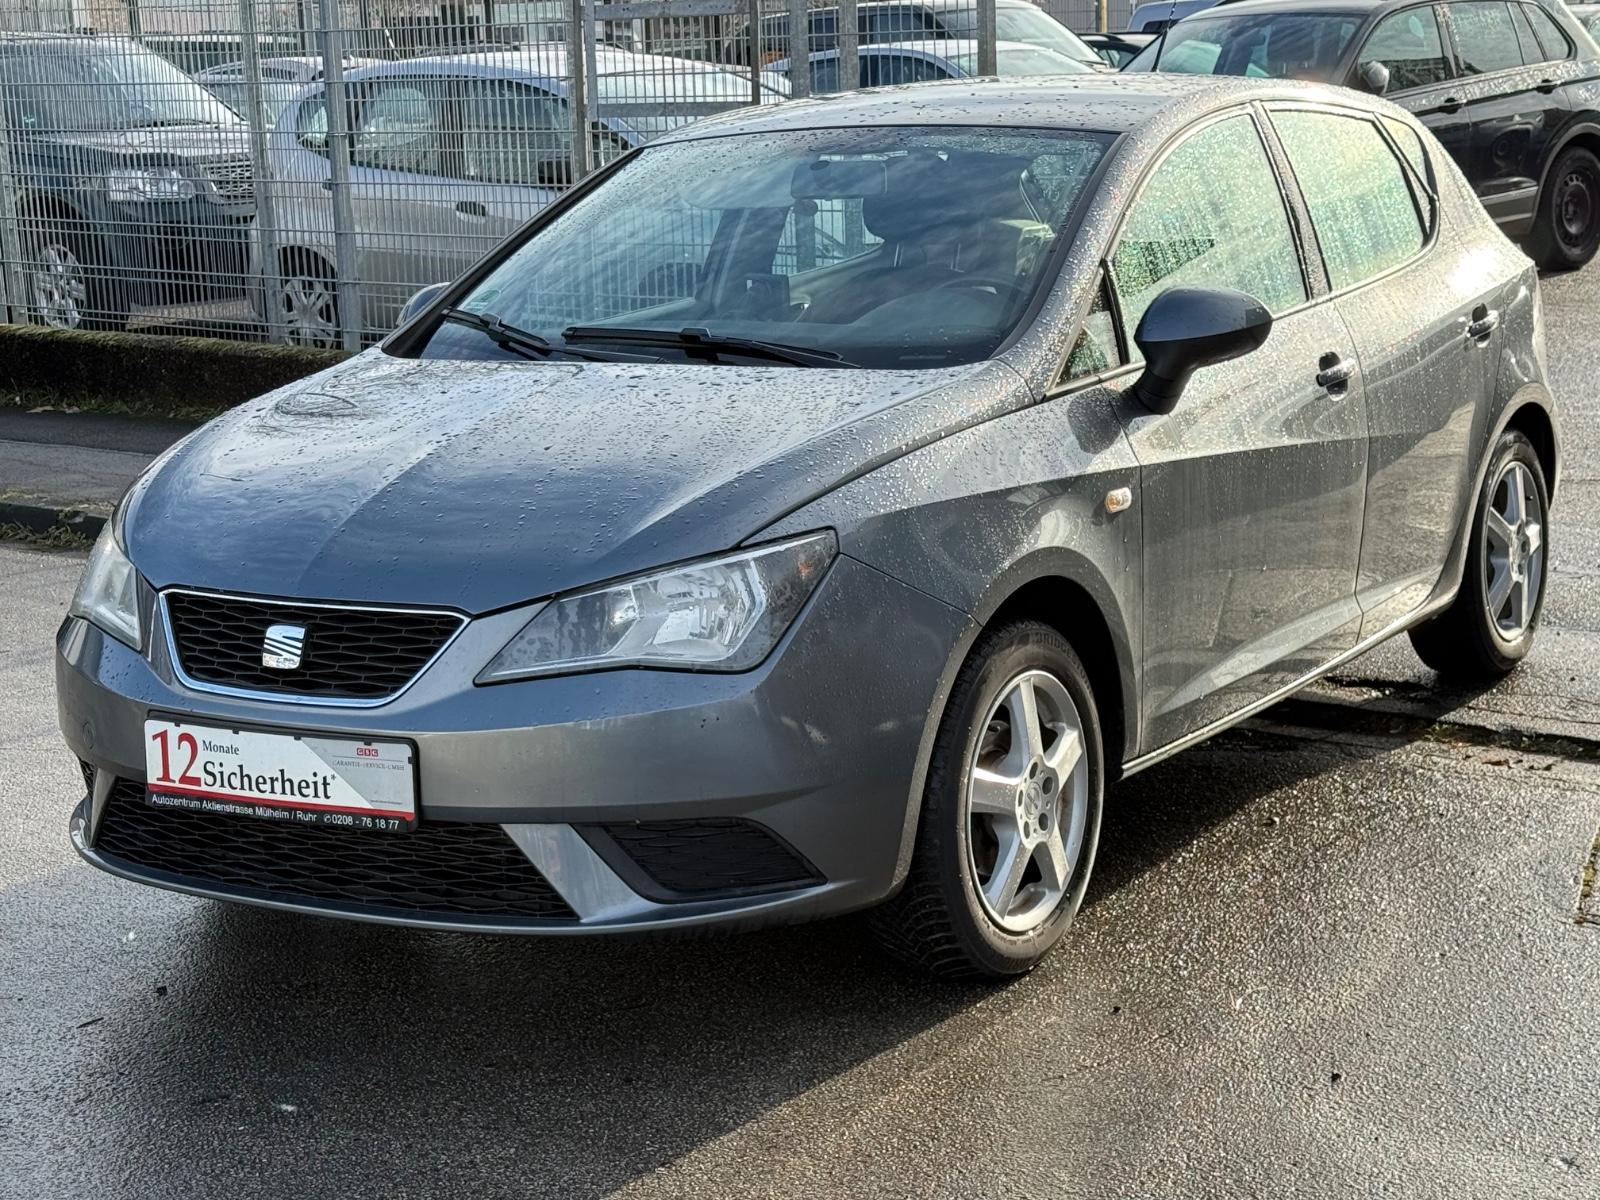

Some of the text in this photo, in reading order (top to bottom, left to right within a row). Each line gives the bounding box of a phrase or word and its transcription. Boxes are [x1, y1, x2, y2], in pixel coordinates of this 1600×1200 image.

[152, 729, 202, 788] 12
[202, 739, 240, 756] Monate
[152, 794, 201, 809] Autozentrum
[202, 799, 254, 815] Aktienstrasse
[255, 806, 290, 820] Mülheim
[296, 810, 318, 822] Ruhr
[331, 814, 354, 826] 0208
[361, 816, 373, 828] 76
[375, 818, 386, 829] 18
[388, 819, 400, 831] 77
